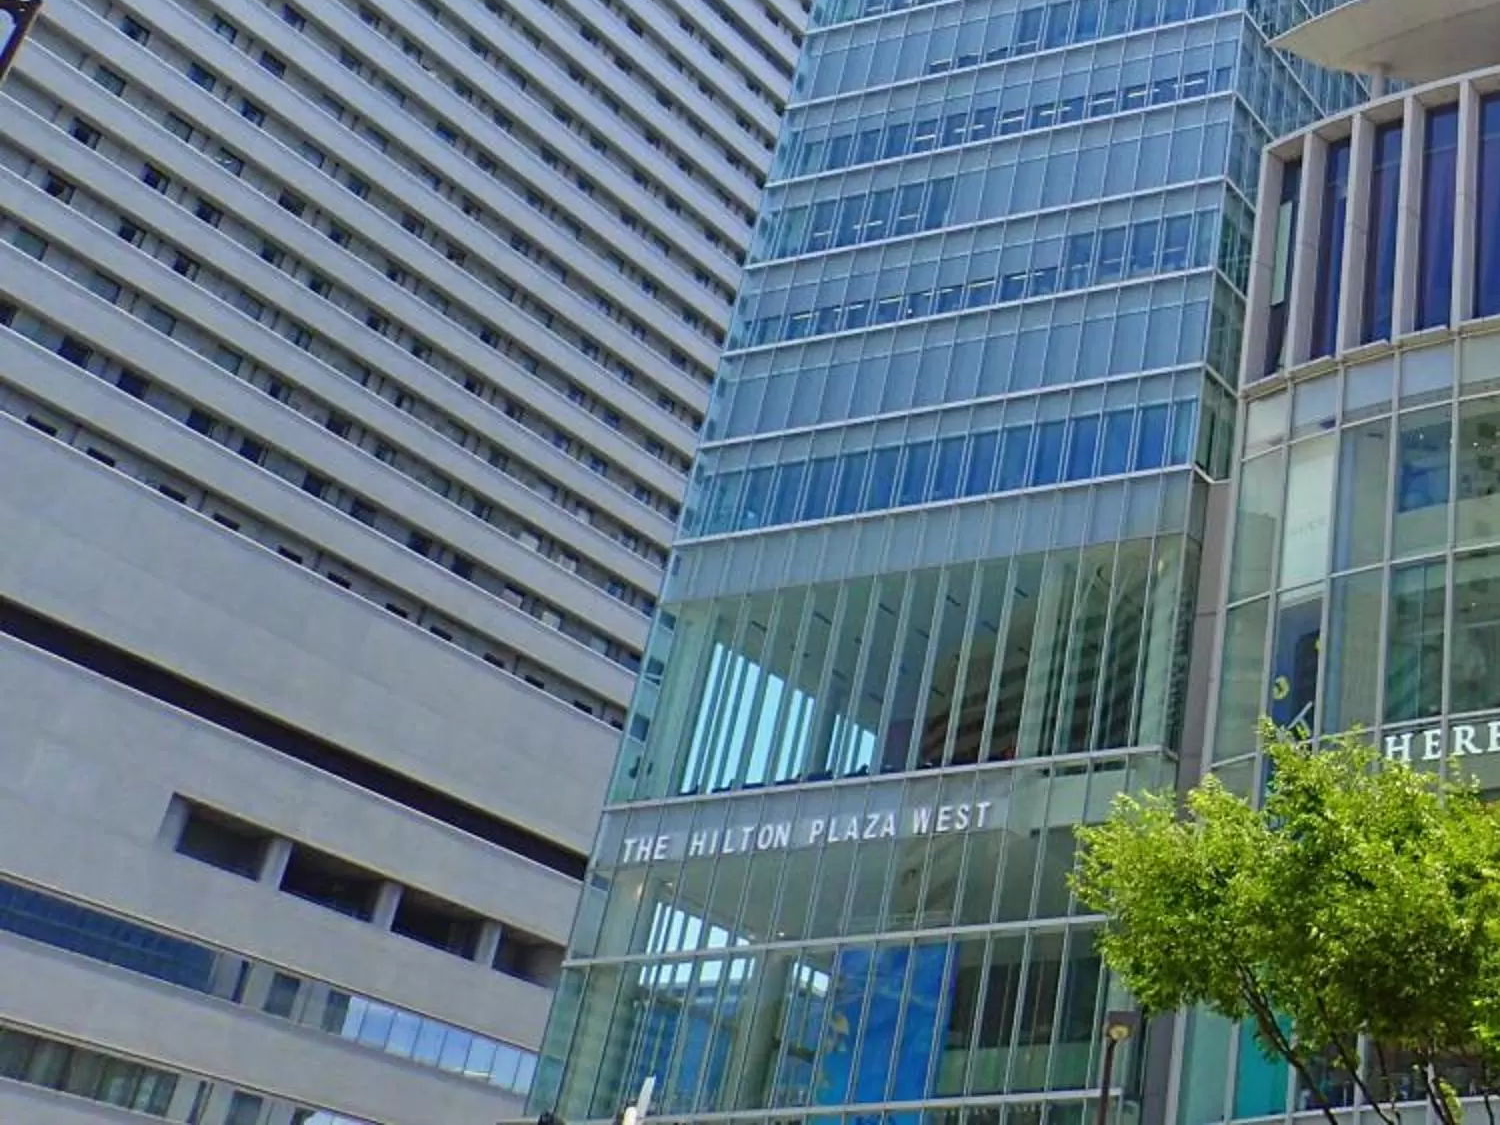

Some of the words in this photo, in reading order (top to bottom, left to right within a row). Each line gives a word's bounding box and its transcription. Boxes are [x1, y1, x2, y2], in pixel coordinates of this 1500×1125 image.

[622, 836, 671, 863] THE
[689, 823, 791, 856] HILTON
[809, 812, 896, 845] PLAZA
[912, 801, 992, 834] WEST
